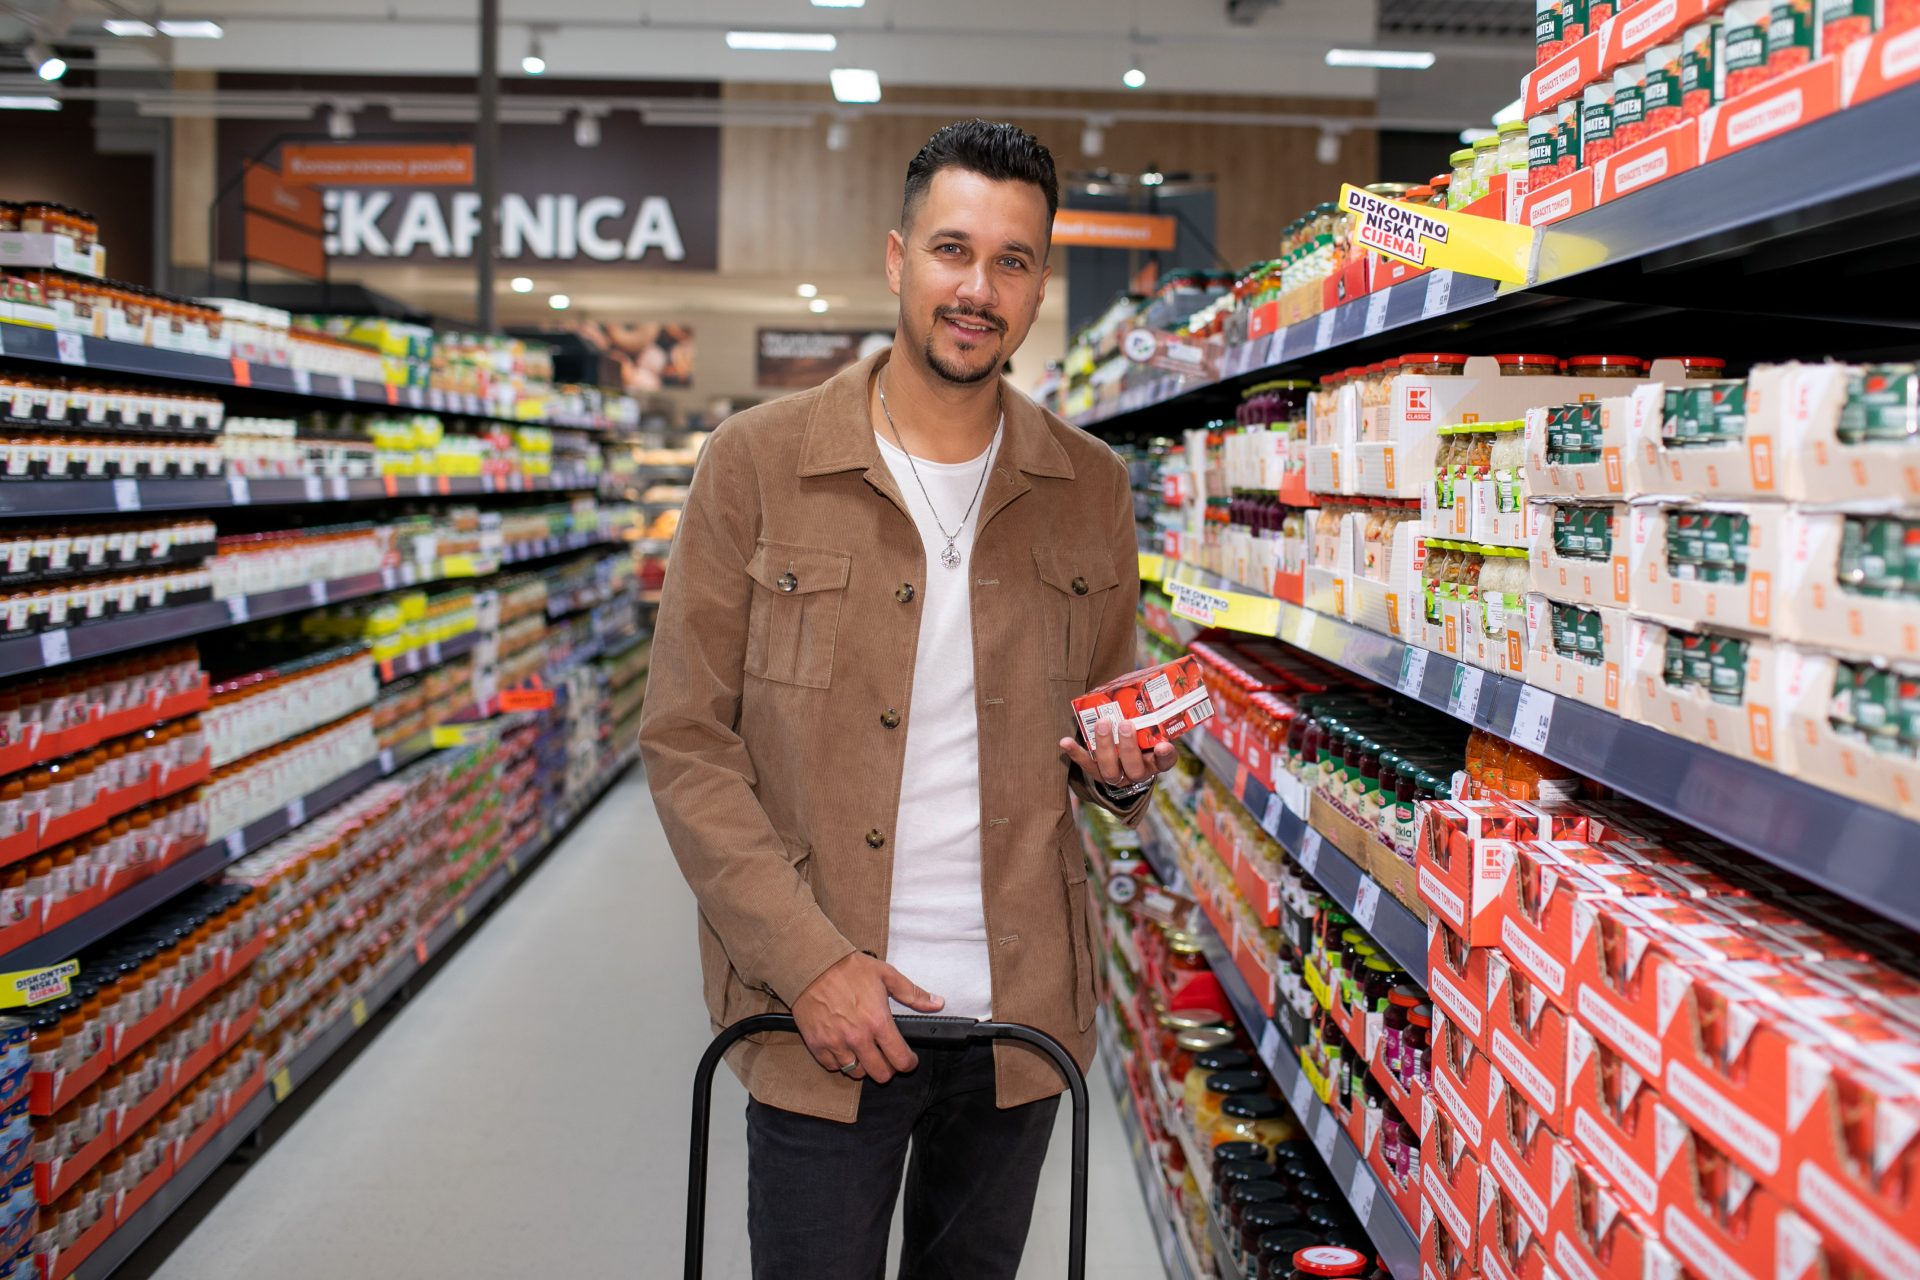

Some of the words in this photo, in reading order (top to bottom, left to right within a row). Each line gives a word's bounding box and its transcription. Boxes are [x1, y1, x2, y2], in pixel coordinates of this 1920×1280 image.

[1539, 77, 1559, 95] GEHACKTE
[1559, 66, 1578, 82] TOMATEN
[322, 189, 685, 261] EKARNICA
[1349, 191, 1447, 238] DISKONTNO
[1532, 204, 1552, 220] GEHACKTE
[1552, 198, 1570, 212] TOMATEN
[1361, 226, 1422, 259] CIJENA!
[1366, 212, 1415, 242] NISKA
[1406, 413, 1431, 421] CLASSIC
[1169, 582, 1229, 608] DISKONTNO
[1180, 595, 1209, 610] NISKA
[1421, 872, 1441, 899] PASSIERTE
[1441, 891, 1462, 916] TOMATEN
[16, 964, 74, 989] DISKONTNO
[29, 977, 60, 992] NISKA
[1531, 953, 1562, 987] TOMATEN
[1433, 974, 1456, 1006] PASSIERTE
[1456, 997, 1479, 1029] TOMATEN
[1495, 1036, 1524, 1075] PASSIERTE
[1523, 1066, 1552, 1104] TOMATEN
[1436, 1073, 1457, 1108] PASSIERTE
[1457, 1101, 1479, 1137] TOMATEN
[1493, 1147, 1519, 1186] PASSIERTE
[1519, 1182, 1545, 1223] TOMATEN
[1425, 1170, 1447, 1208] PASSIERTE
[1447, 1203, 1469, 1242] TOMATEN
